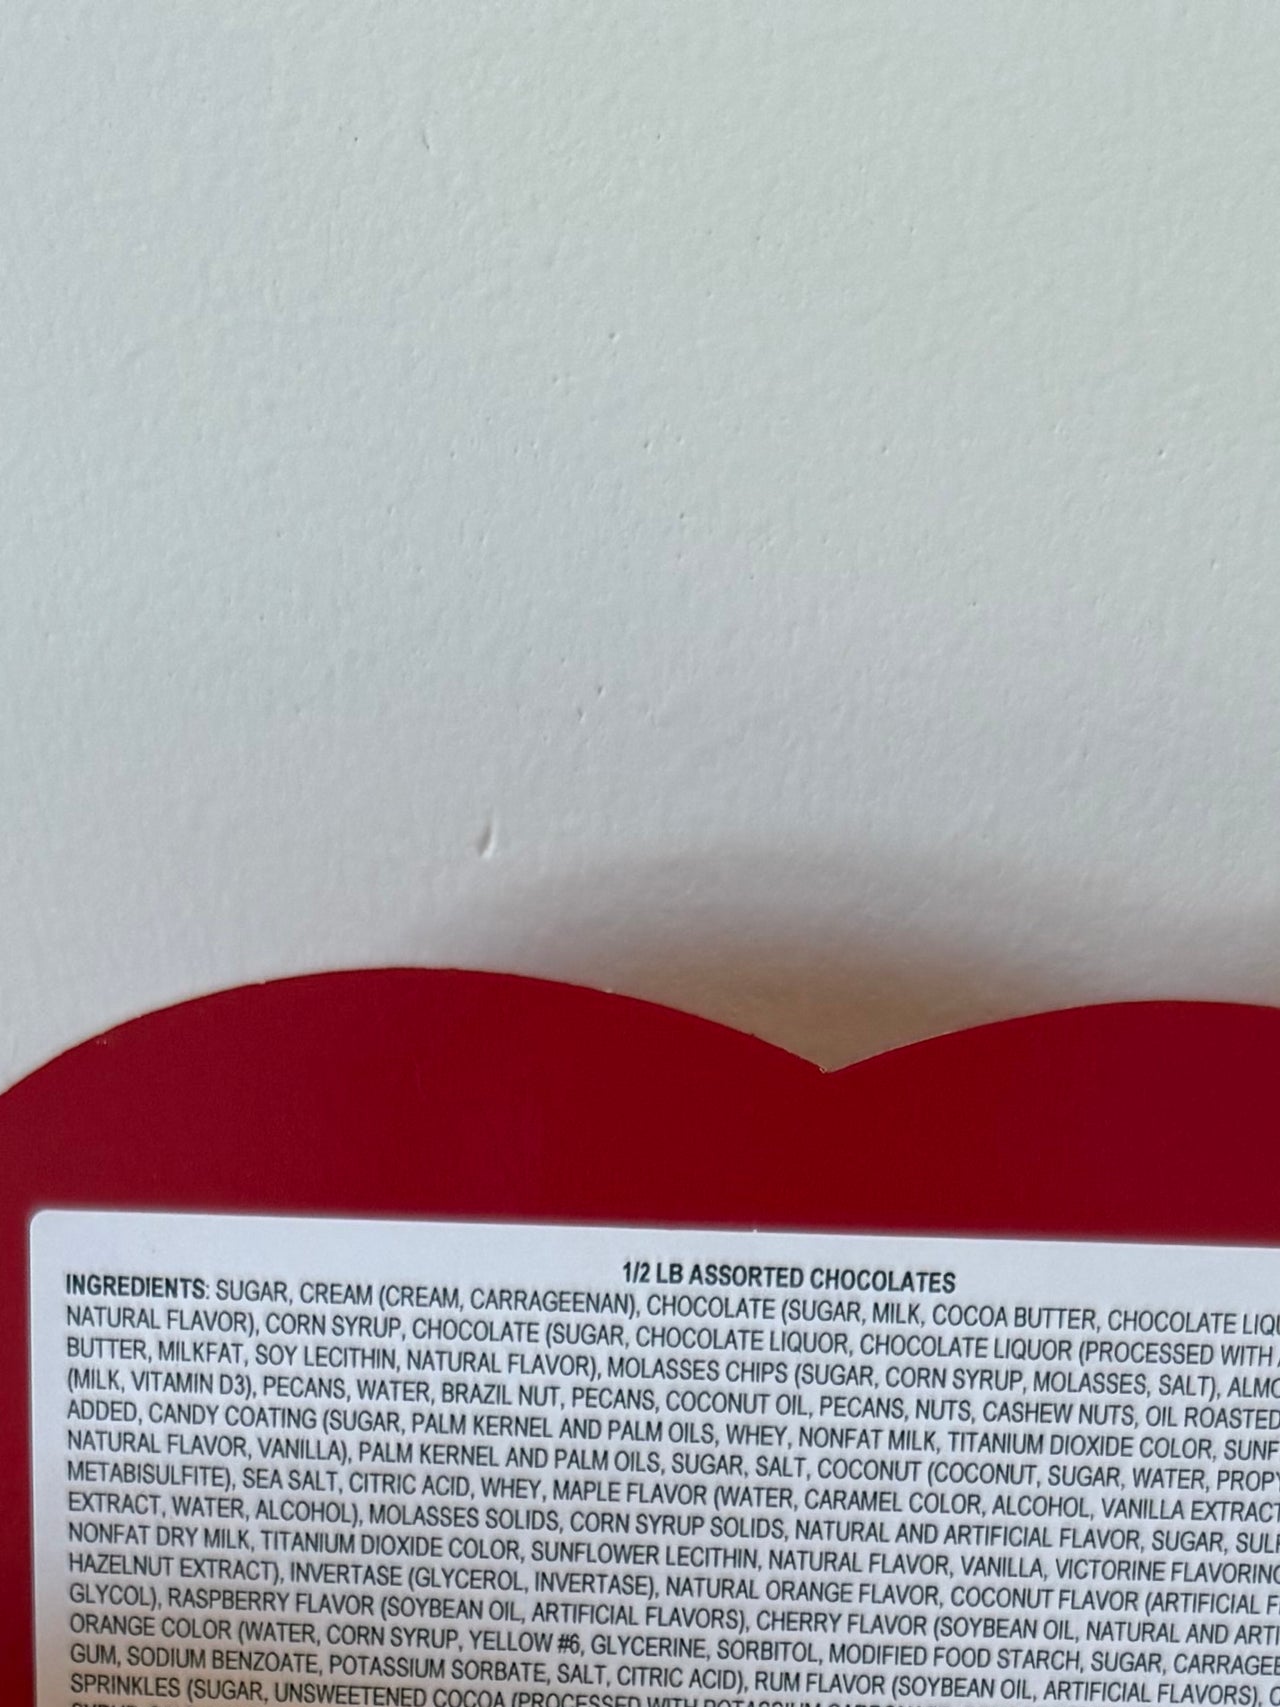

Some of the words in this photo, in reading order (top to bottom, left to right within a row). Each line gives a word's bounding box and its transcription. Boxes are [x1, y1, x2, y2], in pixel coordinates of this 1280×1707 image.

[65, 1273, 210, 1300] INGREDIENTS:
[215, 1277, 293, 1306] SUGAR,
[299, 1281, 373, 1306] CREAM
[378, 1284, 464, 1313] (CREAM,
[469, 1287, 640, 1320] CARRAGEENAN),
[646, 1293, 776, 1320] CHOCOLATE
[780, 1297, 866, 1326] (SUGAR,
[872, 1301, 926, 1328] MILK,
[931, 1302, 1008, 1327] COCOA
[1013, 1305, 1101, 1334] BUTTER,
[1107, 1308, 1237, 1335] CHOCOLATE
[622, 1260, 651, 1284] 1/2
[655, 1261, 684, 1284] LB
[688, 1262, 805, 1289] ASSORTED
[809, 1266, 956, 1294] CHOCOLATES
[66, 1304, 161, 1330] NATURAL
[166, 1308, 260, 1338] FLAVOR),
[264, 1311, 326, 1336] CORN
[330, 1313, 406, 1341] SYRUP,
[411, 1317, 540, 1343] CHOCOLATE
[545, 1321, 629, 1350] (SUGAR,
[635, 1324, 764, 1351] CHOCOLATE
[769, 1329, 854, 1358] LIQUOR,
[859, 1332, 989, 1359] CHOCOLATE
[993, 1337, 1073, 1361] LIQUOR
[1078, 1339, 1215, 1367] (PROCESSED
[1220, 1343, 1273, 1367] WITH
